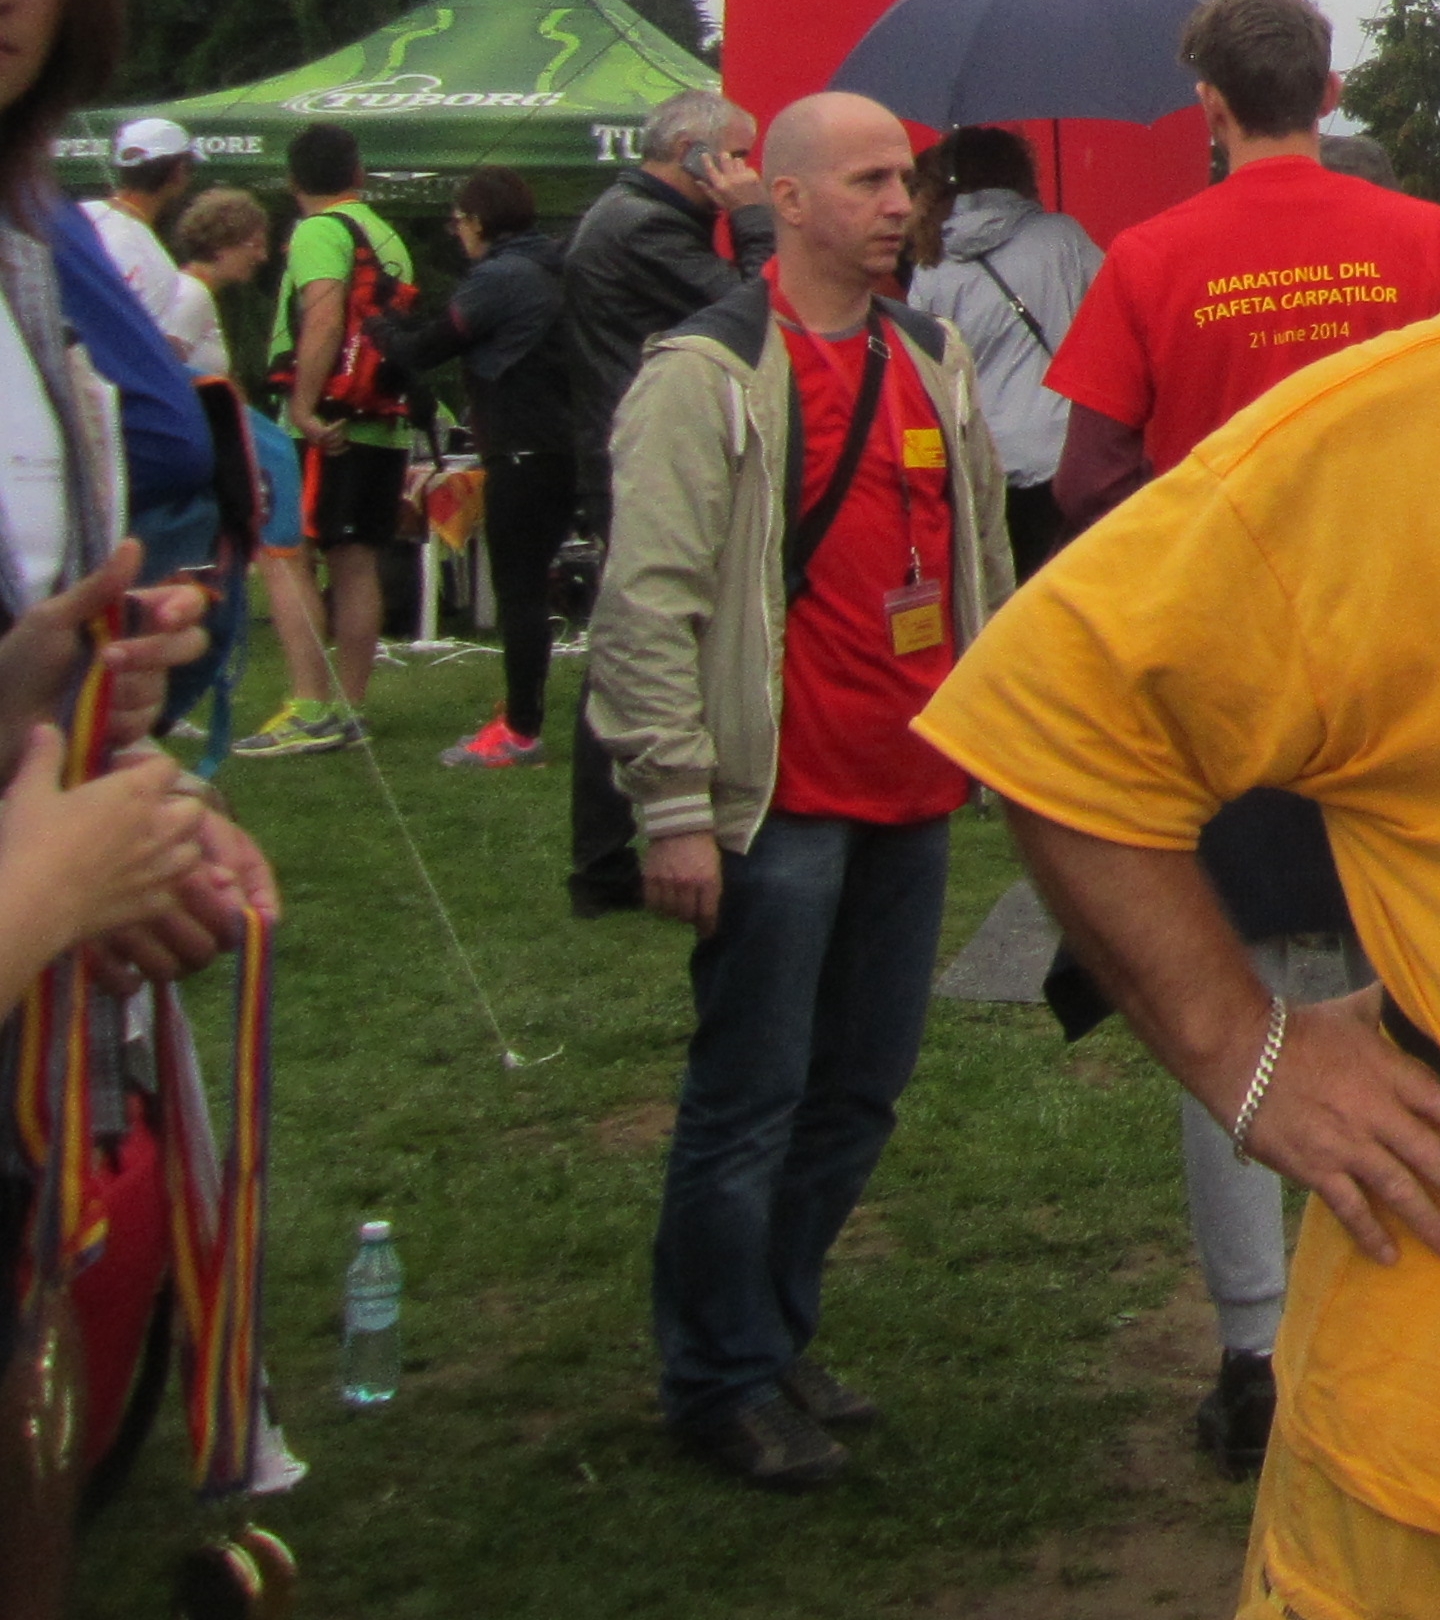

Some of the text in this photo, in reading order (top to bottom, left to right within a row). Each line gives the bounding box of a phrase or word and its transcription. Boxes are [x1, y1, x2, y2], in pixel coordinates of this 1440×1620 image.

[323, 92, 565, 108] TUBORG
[1207, 262, 1381, 297] MARATONUL DHL
[1248, 331, 1267, 348] 21
[1310, 322, 1350, 340] 2014
